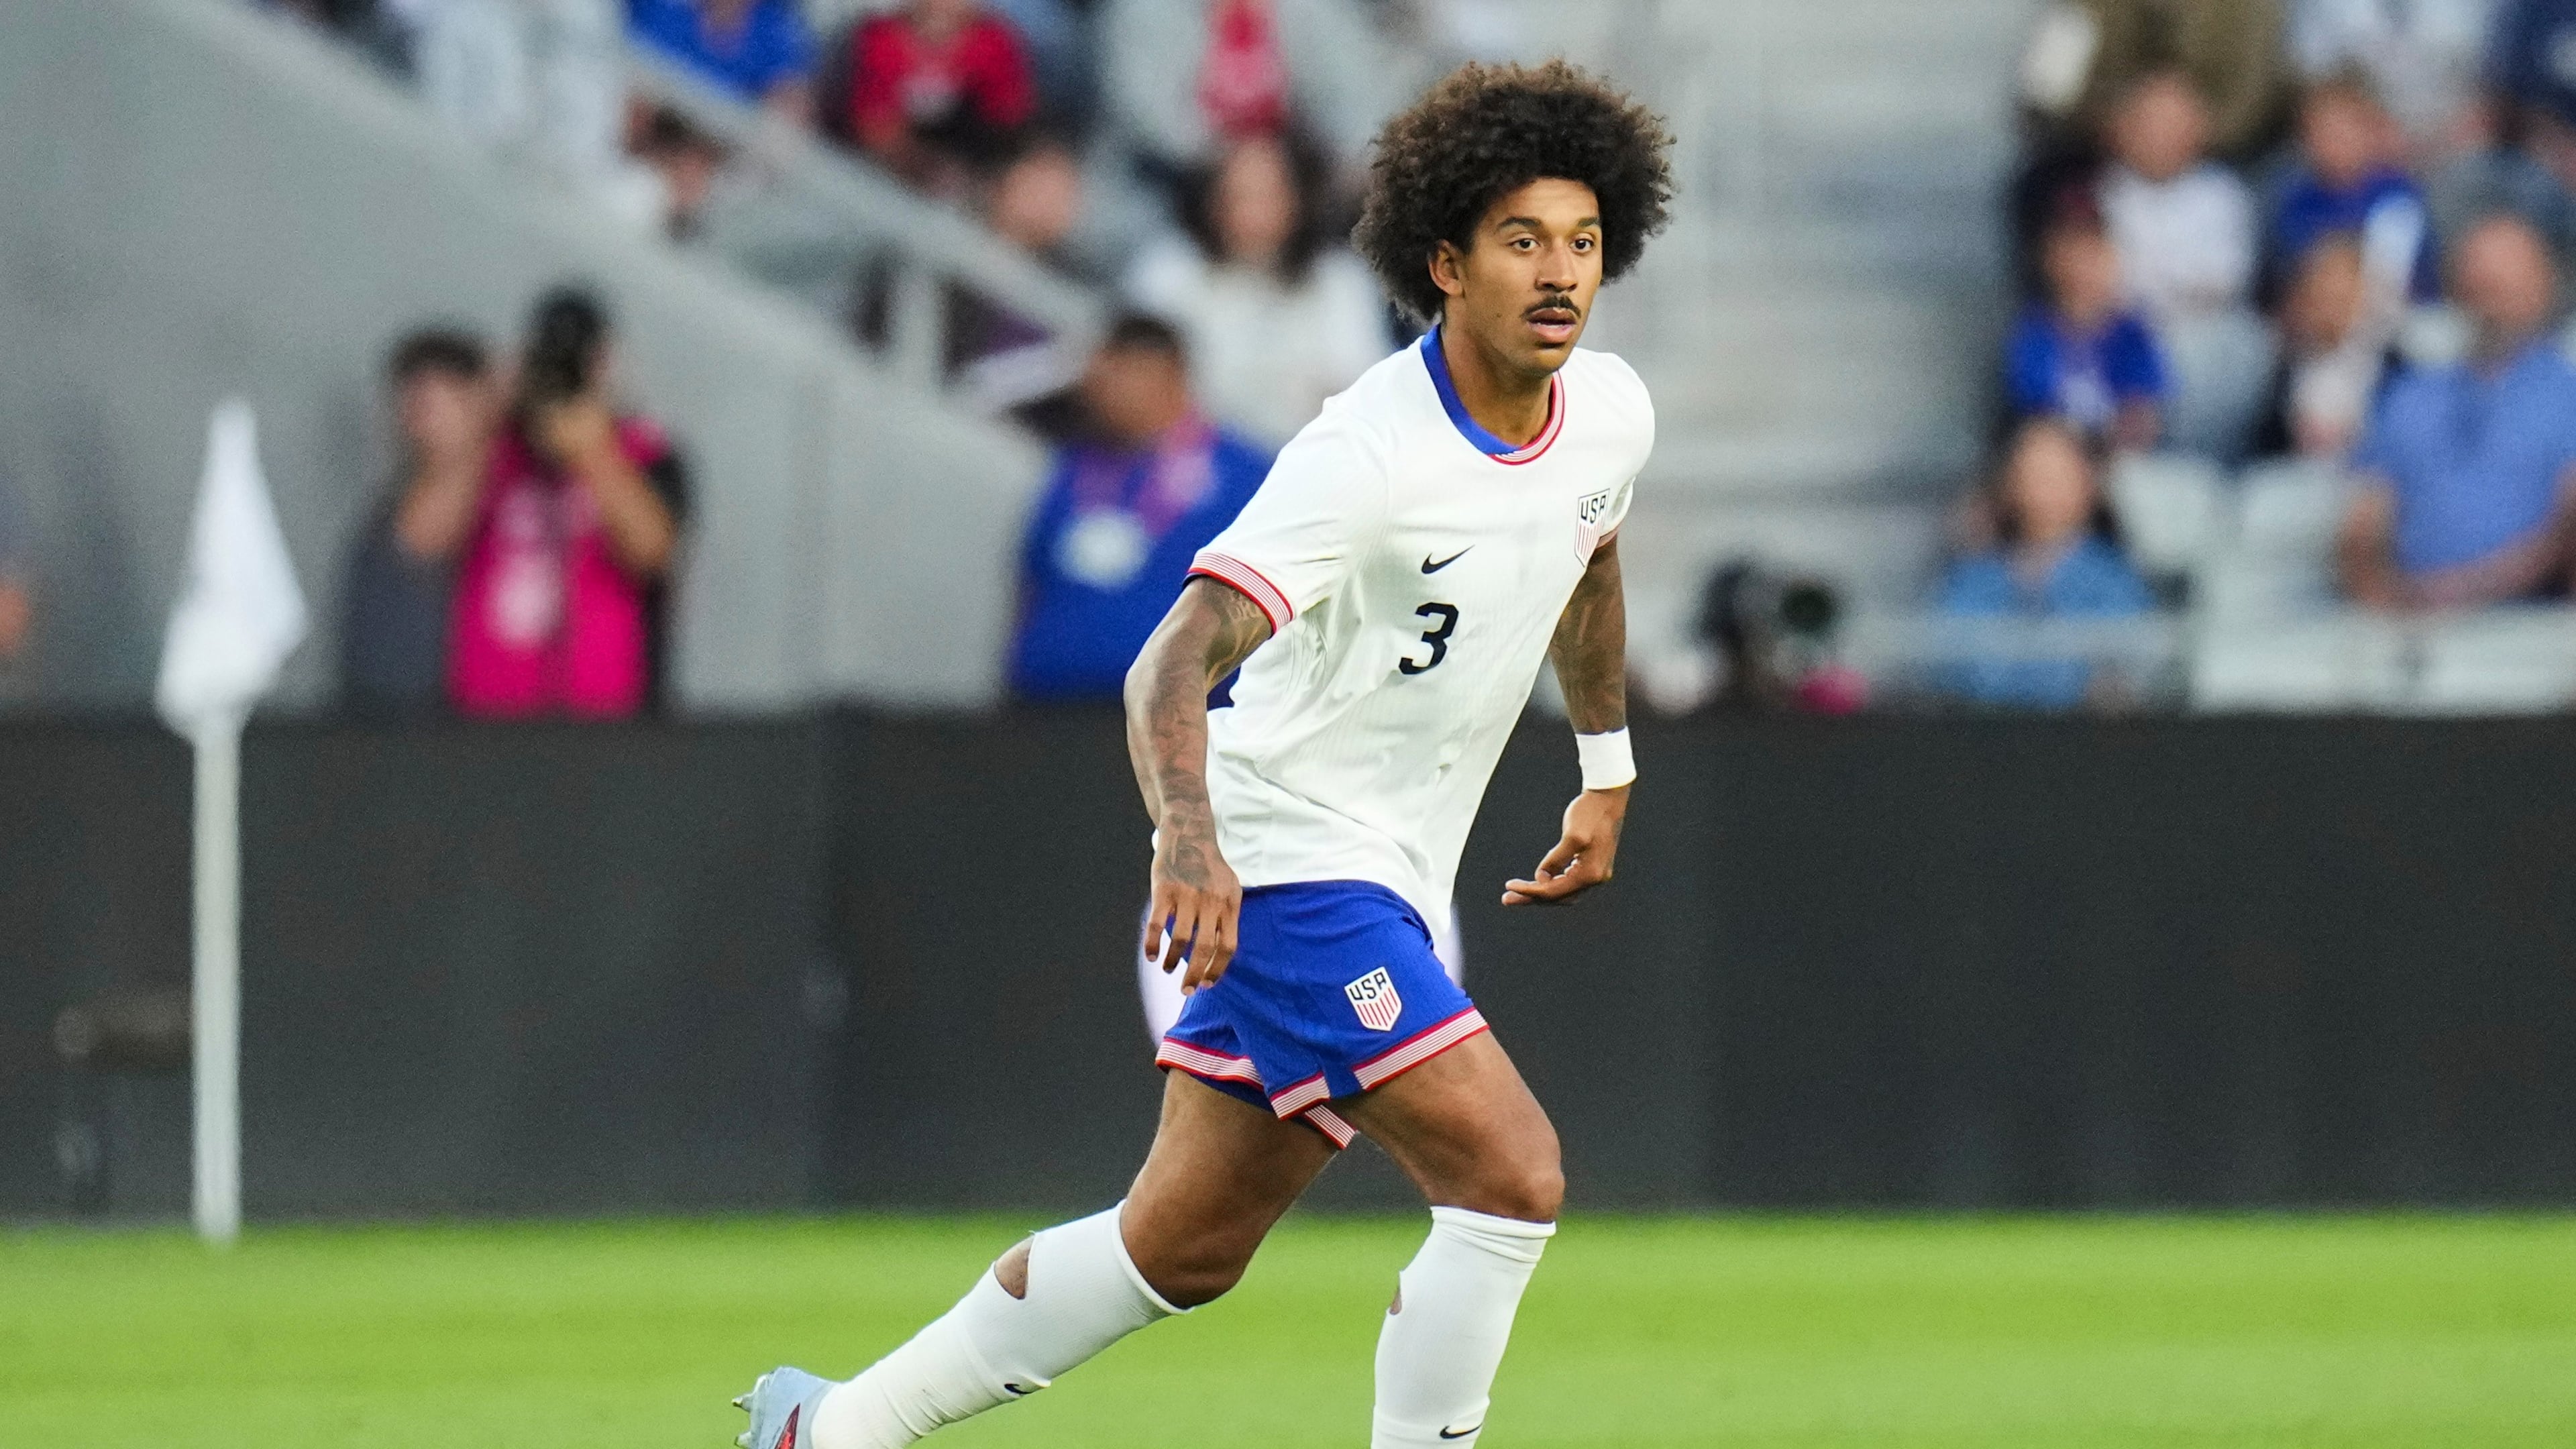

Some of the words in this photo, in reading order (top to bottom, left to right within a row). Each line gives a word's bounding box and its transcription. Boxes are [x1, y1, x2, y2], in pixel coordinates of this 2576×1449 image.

[1580, 494, 1607, 524] USA
[1399, 602, 1459, 675] 3
[1349, 971, 1387, 1000] USA
